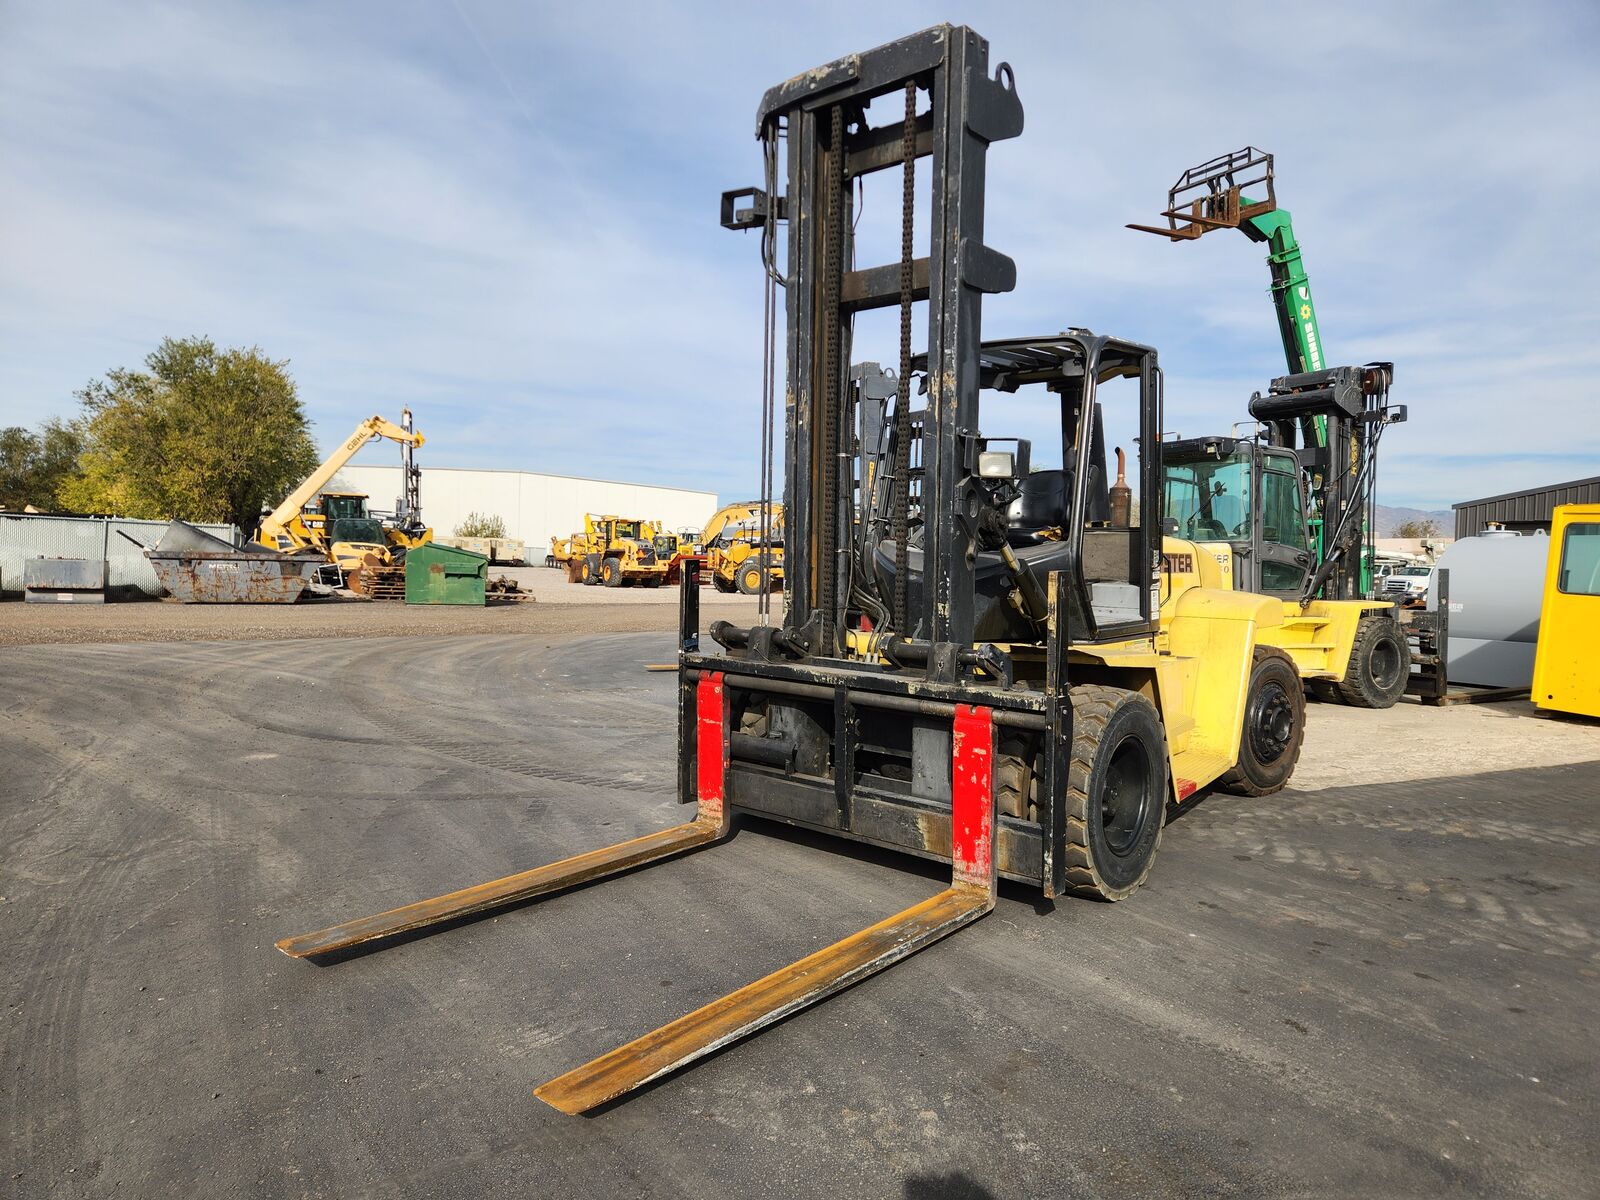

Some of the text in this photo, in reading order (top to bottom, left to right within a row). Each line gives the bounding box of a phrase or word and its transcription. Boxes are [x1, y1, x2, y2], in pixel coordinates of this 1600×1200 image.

[1304, 321, 1322, 372] SUNBE
[346, 432, 367, 451] GEHL
[1161, 553, 1193, 573] STER
